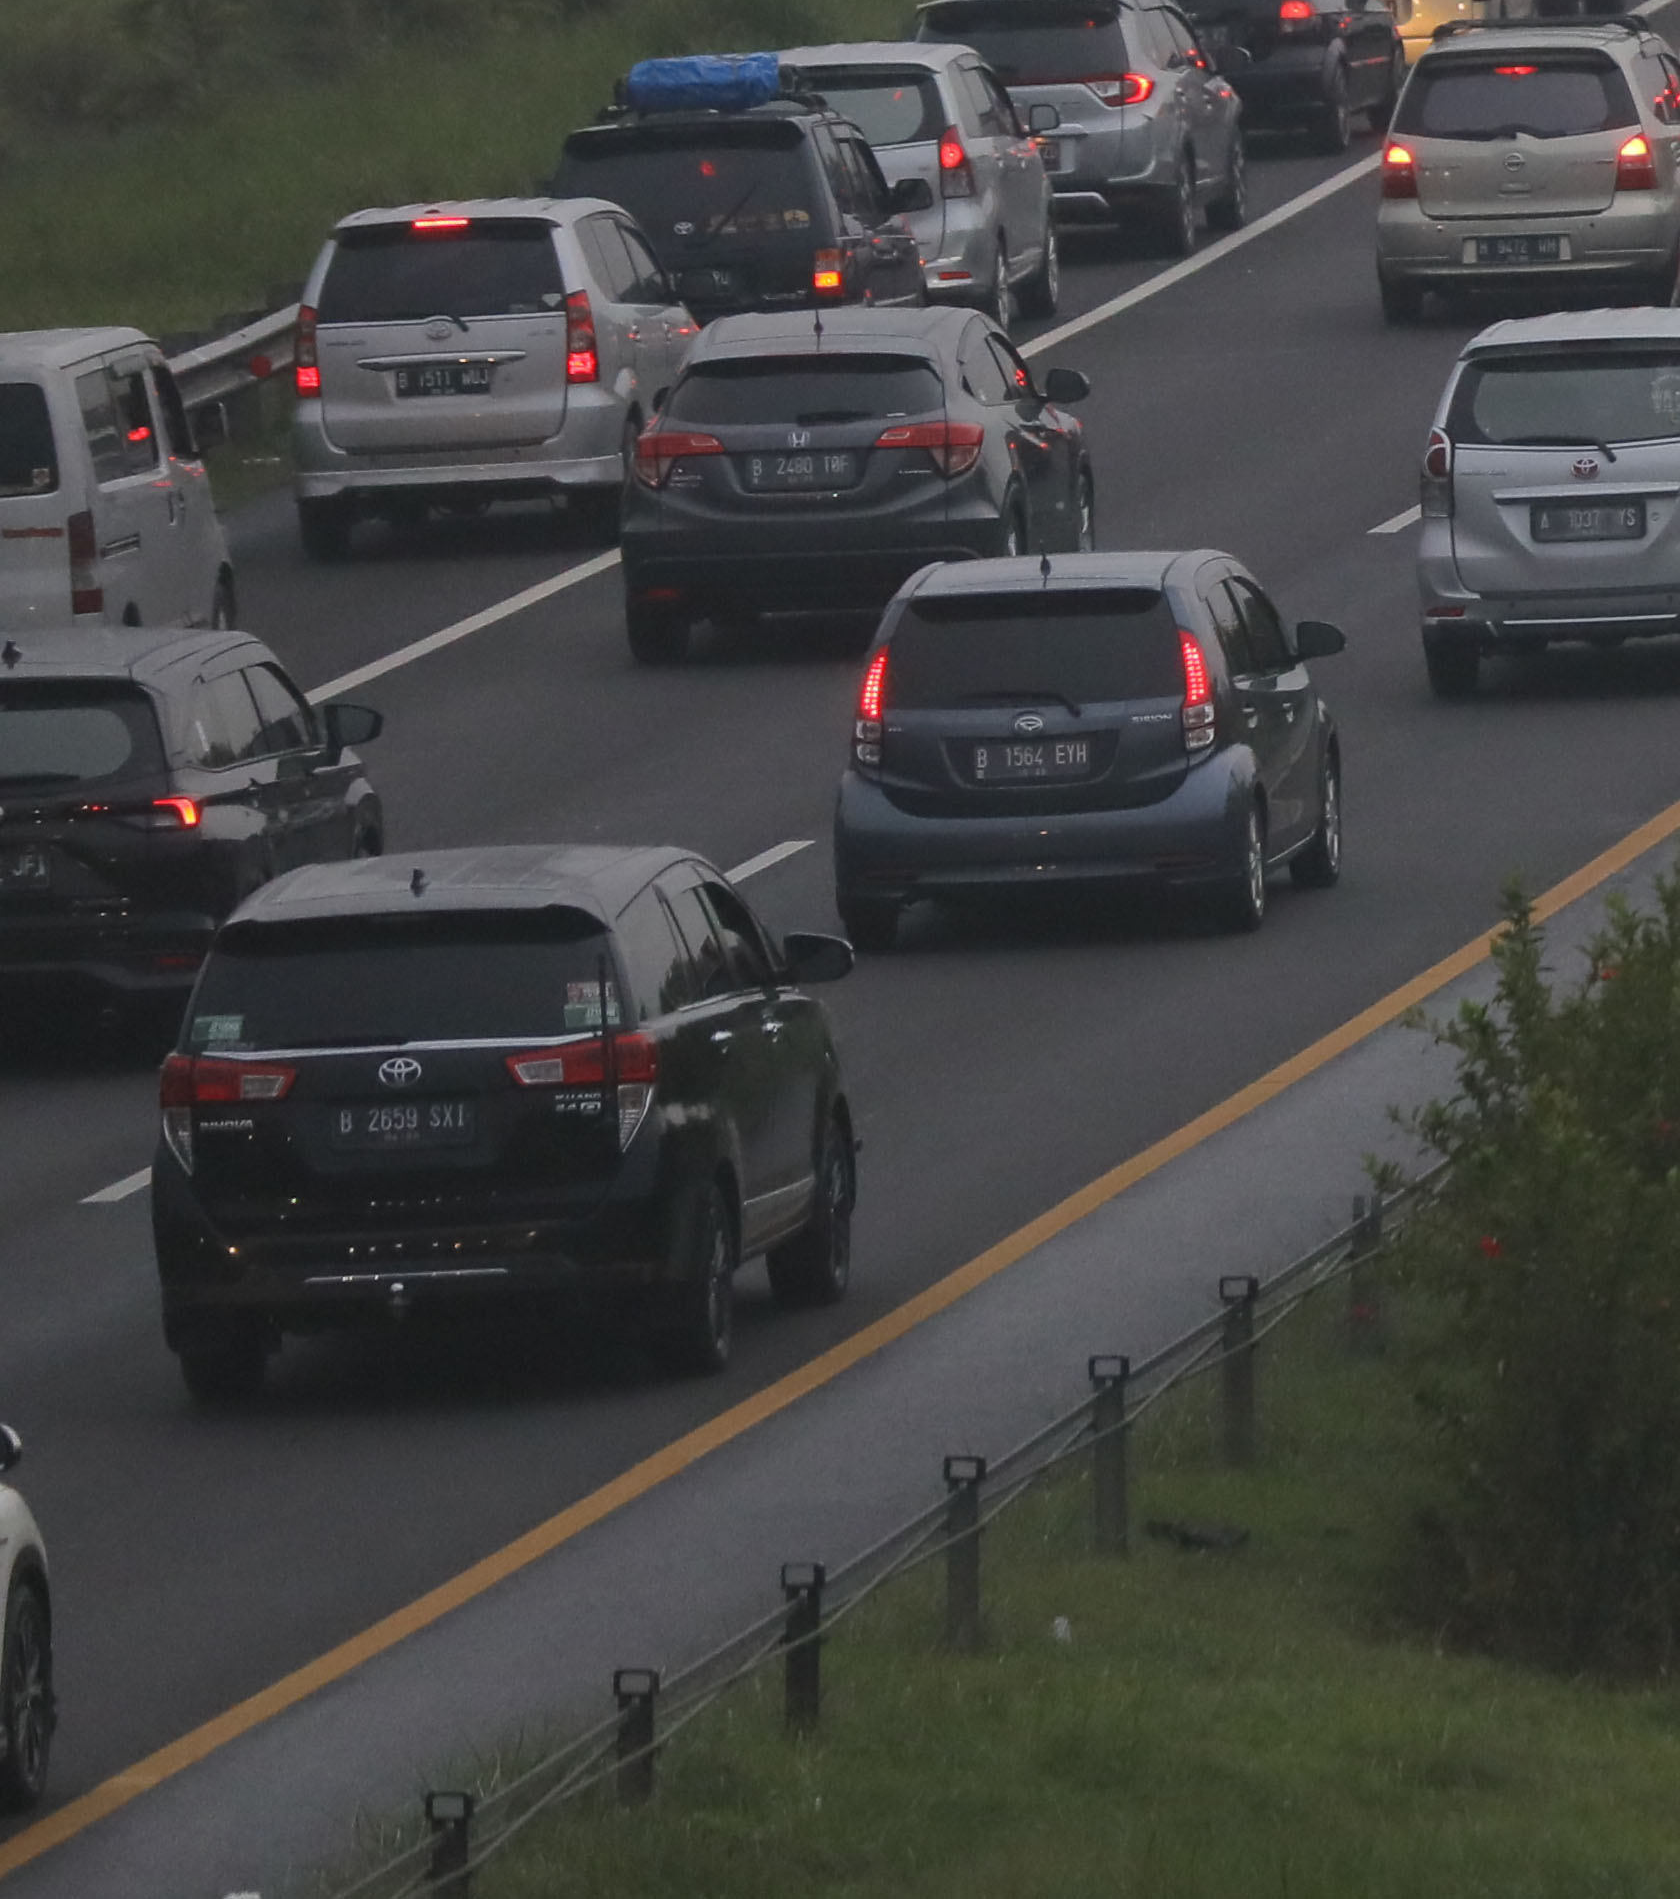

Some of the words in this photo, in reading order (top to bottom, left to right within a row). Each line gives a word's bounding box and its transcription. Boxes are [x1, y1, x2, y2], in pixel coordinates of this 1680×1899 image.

[752, 458, 762, 476] B
[1540, 510, 1549, 529] A
[977, 749, 987, 769] B
[1005, 746, 1044, 767] 1564
[1055, 743, 1087, 765] EYH
[340, 1109, 353, 1135] B
[368, 1105, 418, 1133] 2659
[429, 1102, 465, 1128] SXI
